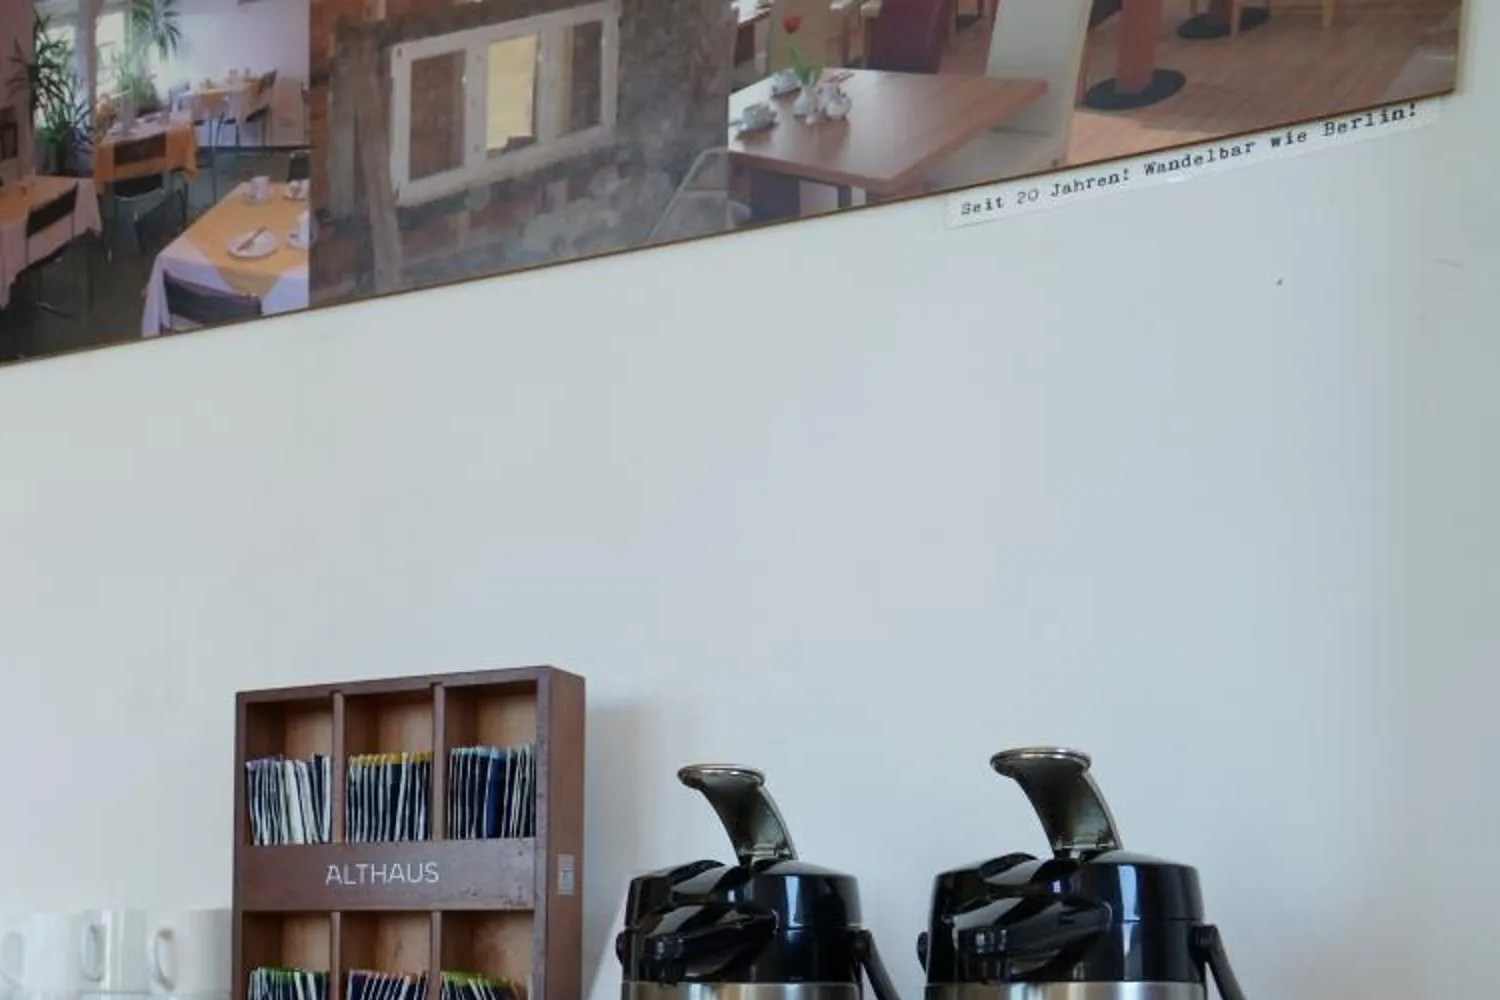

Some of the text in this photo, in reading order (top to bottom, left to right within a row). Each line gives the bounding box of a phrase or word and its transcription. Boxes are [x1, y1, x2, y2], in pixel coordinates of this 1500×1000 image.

[960, 102, 1417, 216] Seit 20 Jahren! Wandelbar wie Berlin!
[324, 861, 440, 887] ALTHAUS
